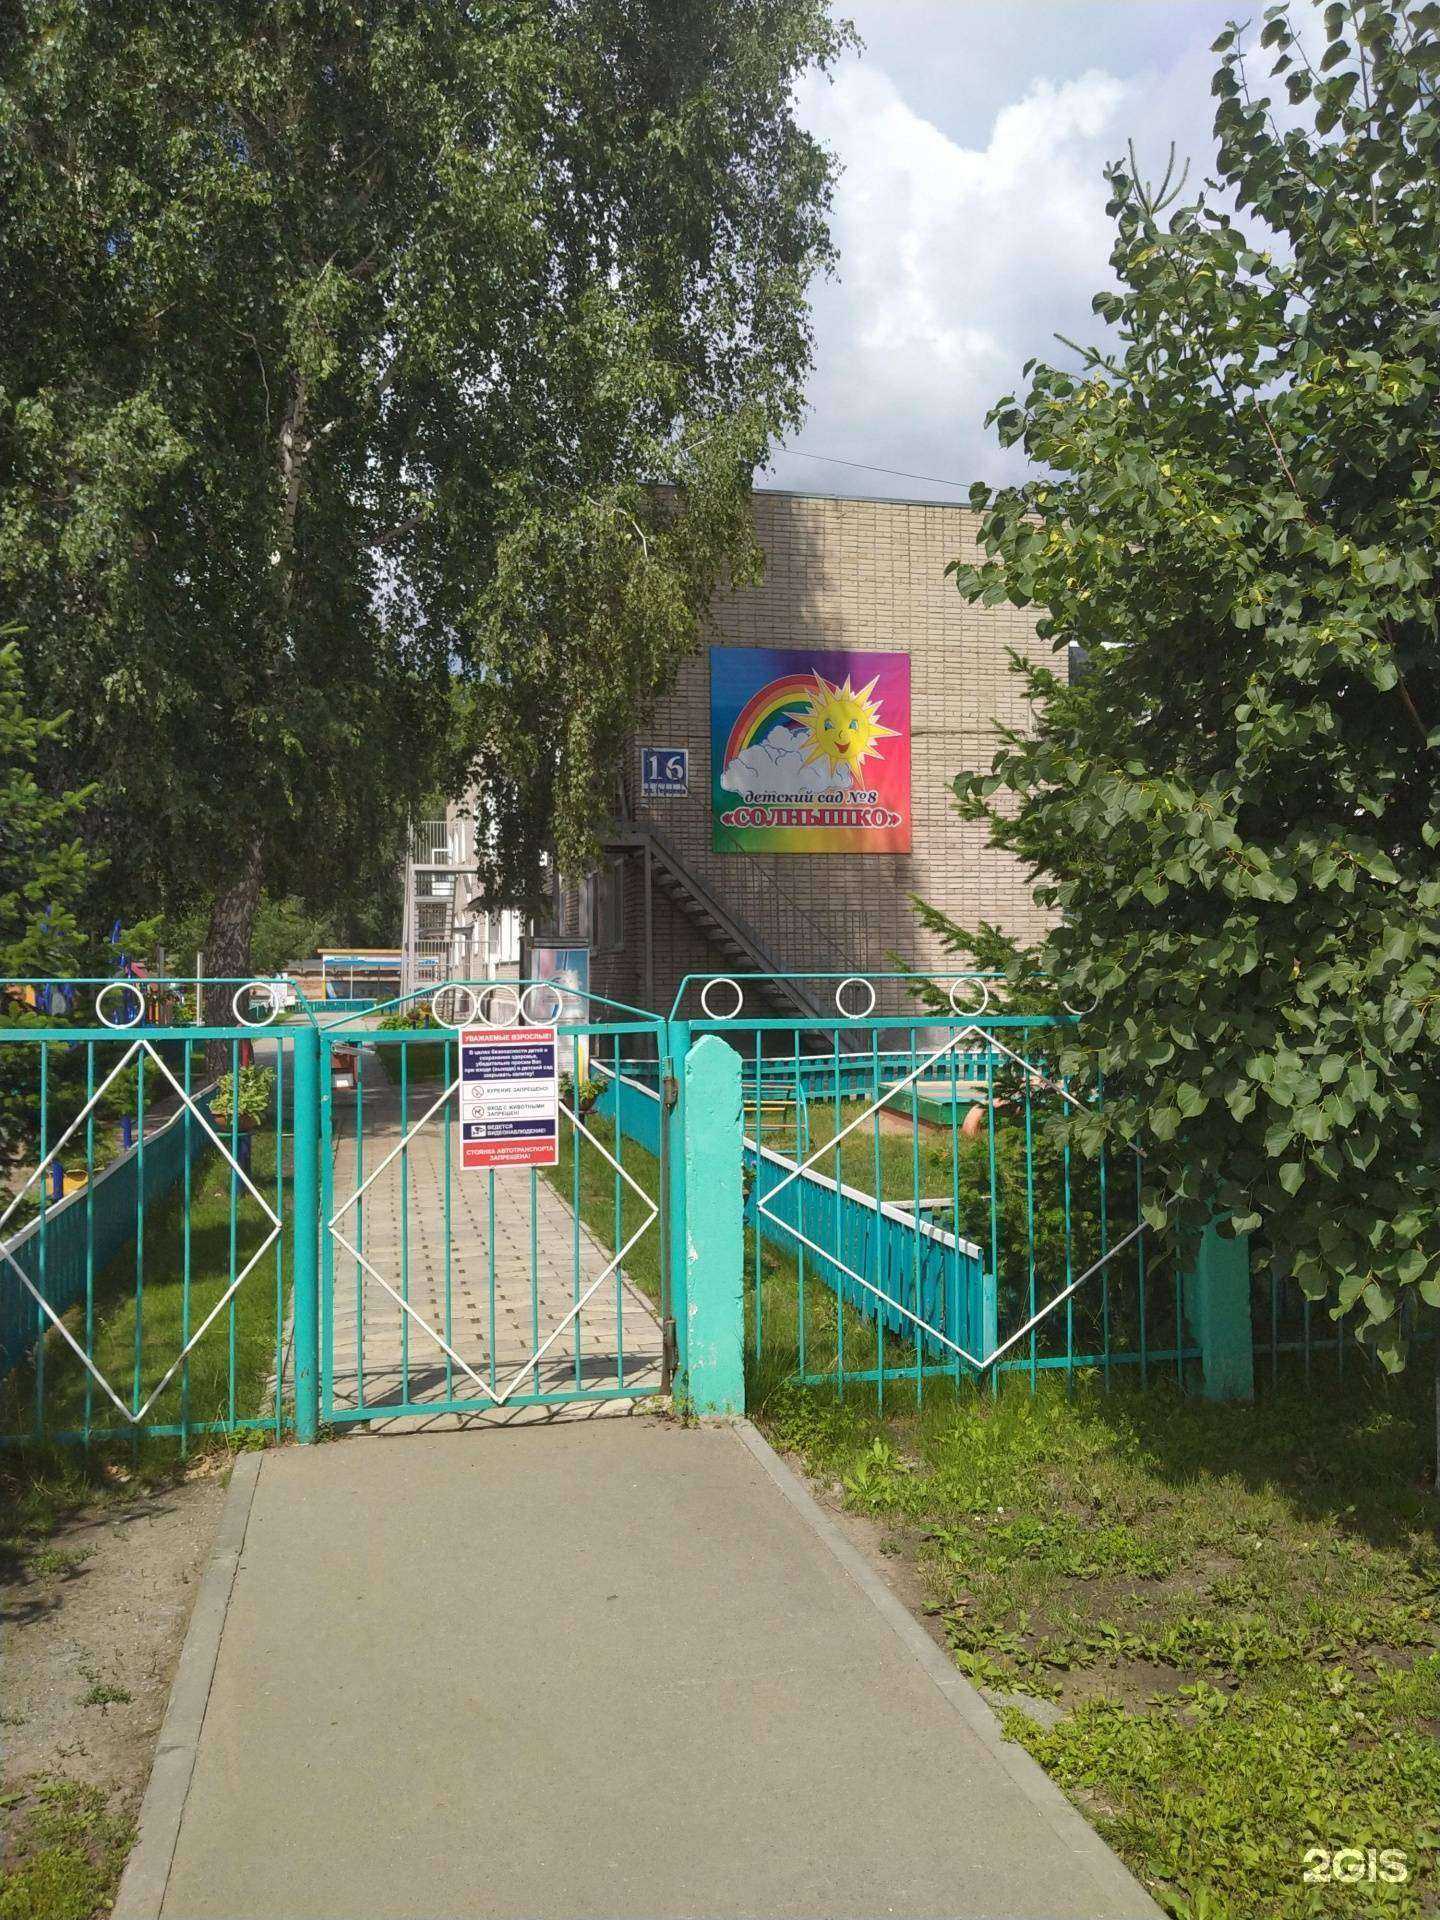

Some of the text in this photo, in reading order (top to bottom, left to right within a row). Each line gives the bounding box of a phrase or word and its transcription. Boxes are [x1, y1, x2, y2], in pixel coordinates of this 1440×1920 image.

[649, 755, 684, 780] 16
[744, 790, 878, 804] детский сад №8
[722, 808, 901, 827] «СОЛНЫШКО»
[464, 1032, 552, 1042] УВАЖАЕМЫЕ ВЗРОСЛЫЕ!
[487, 1128, 547, 1136] ВИДЕОНАБЛЮДЕНИЕ!
[496, 1146, 554, 1154] АВТОТРАНСПОРТА
[489, 1153, 531, 1161] ЗАПРЕЩЕНА!
